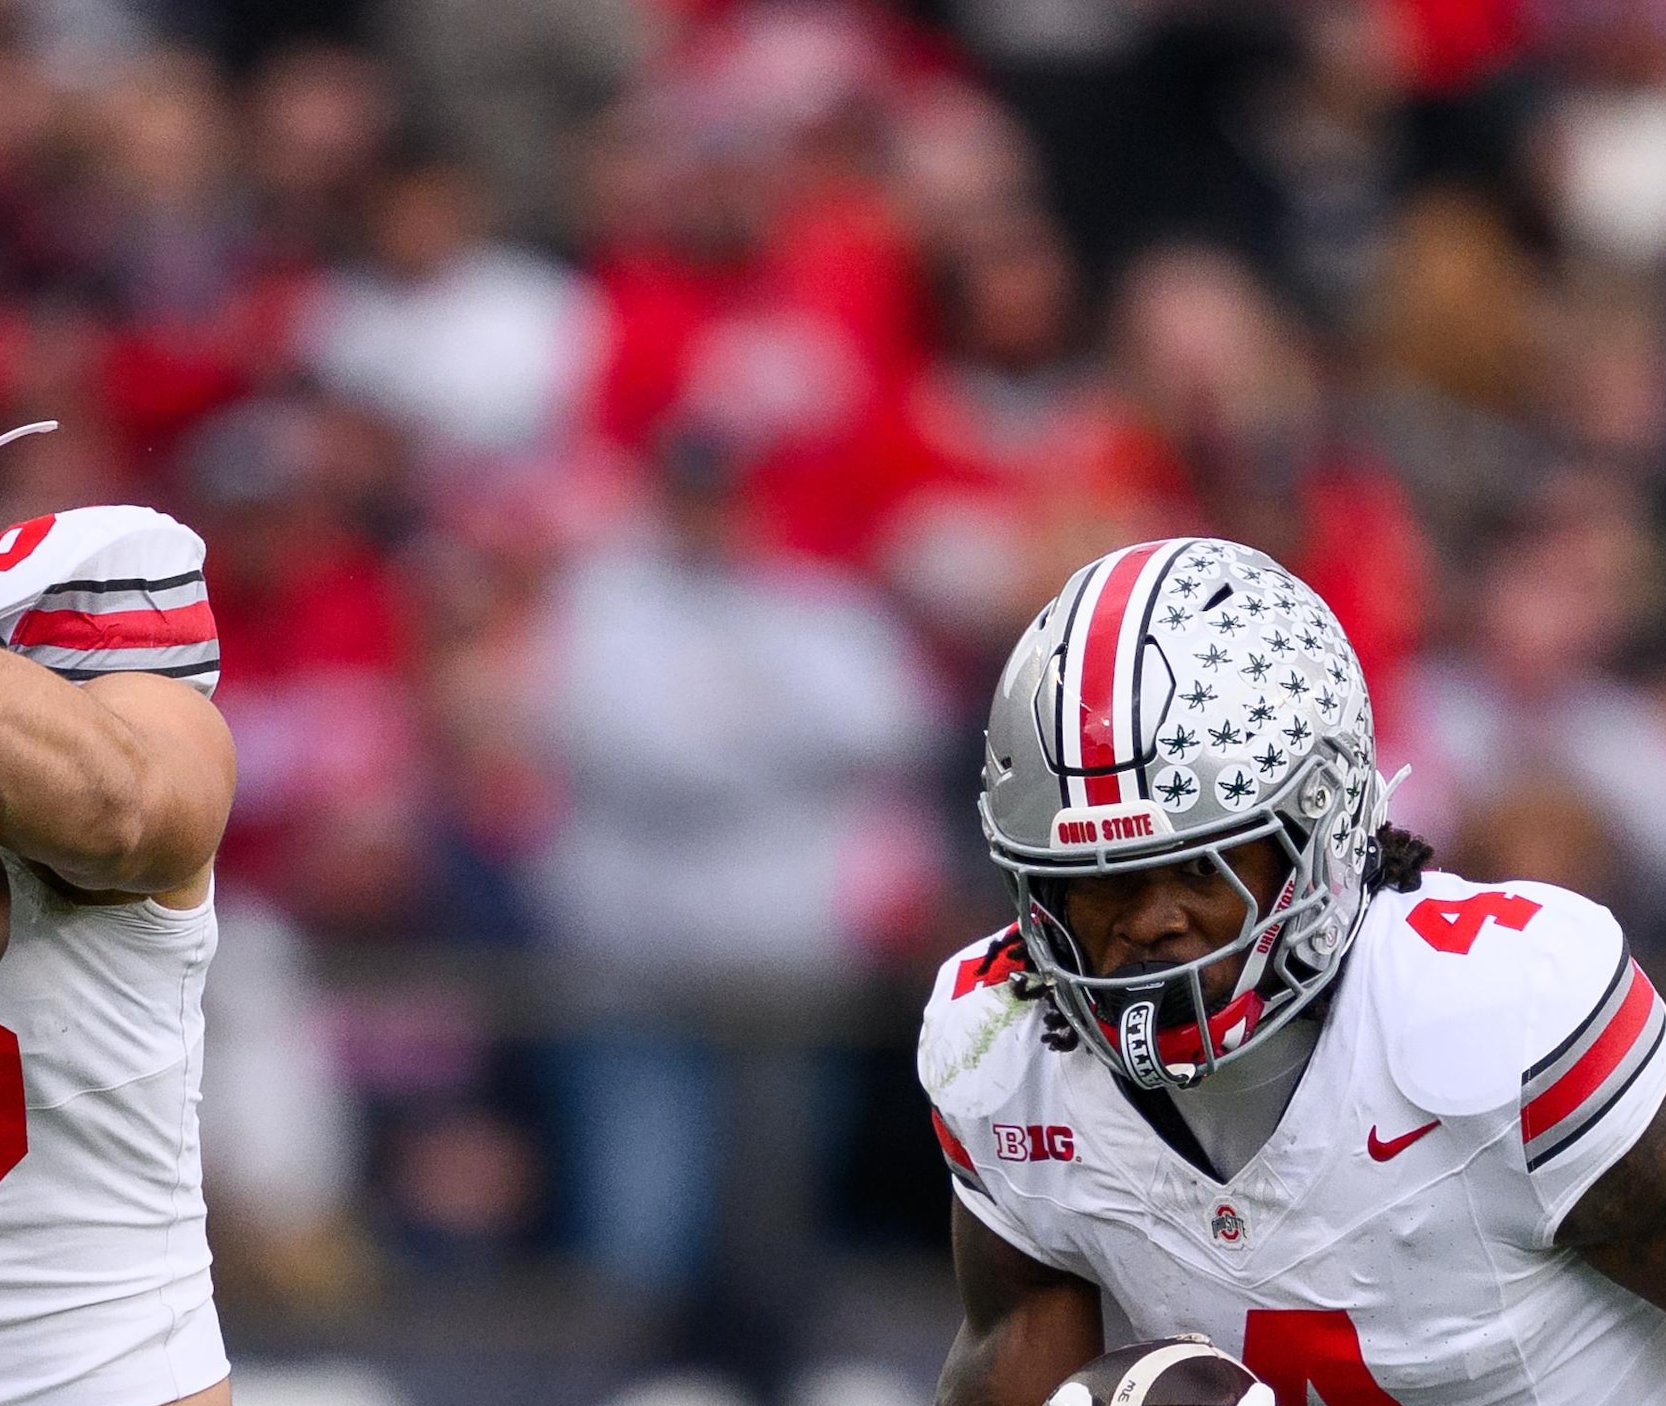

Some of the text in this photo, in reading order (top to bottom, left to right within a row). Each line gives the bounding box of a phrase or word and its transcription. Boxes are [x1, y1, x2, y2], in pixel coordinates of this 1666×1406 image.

[1058, 813, 1154, 844] OHIO STATE
[1405, 891, 1543, 955] 4
[1127, 1009, 1162, 1087] ATTLE
